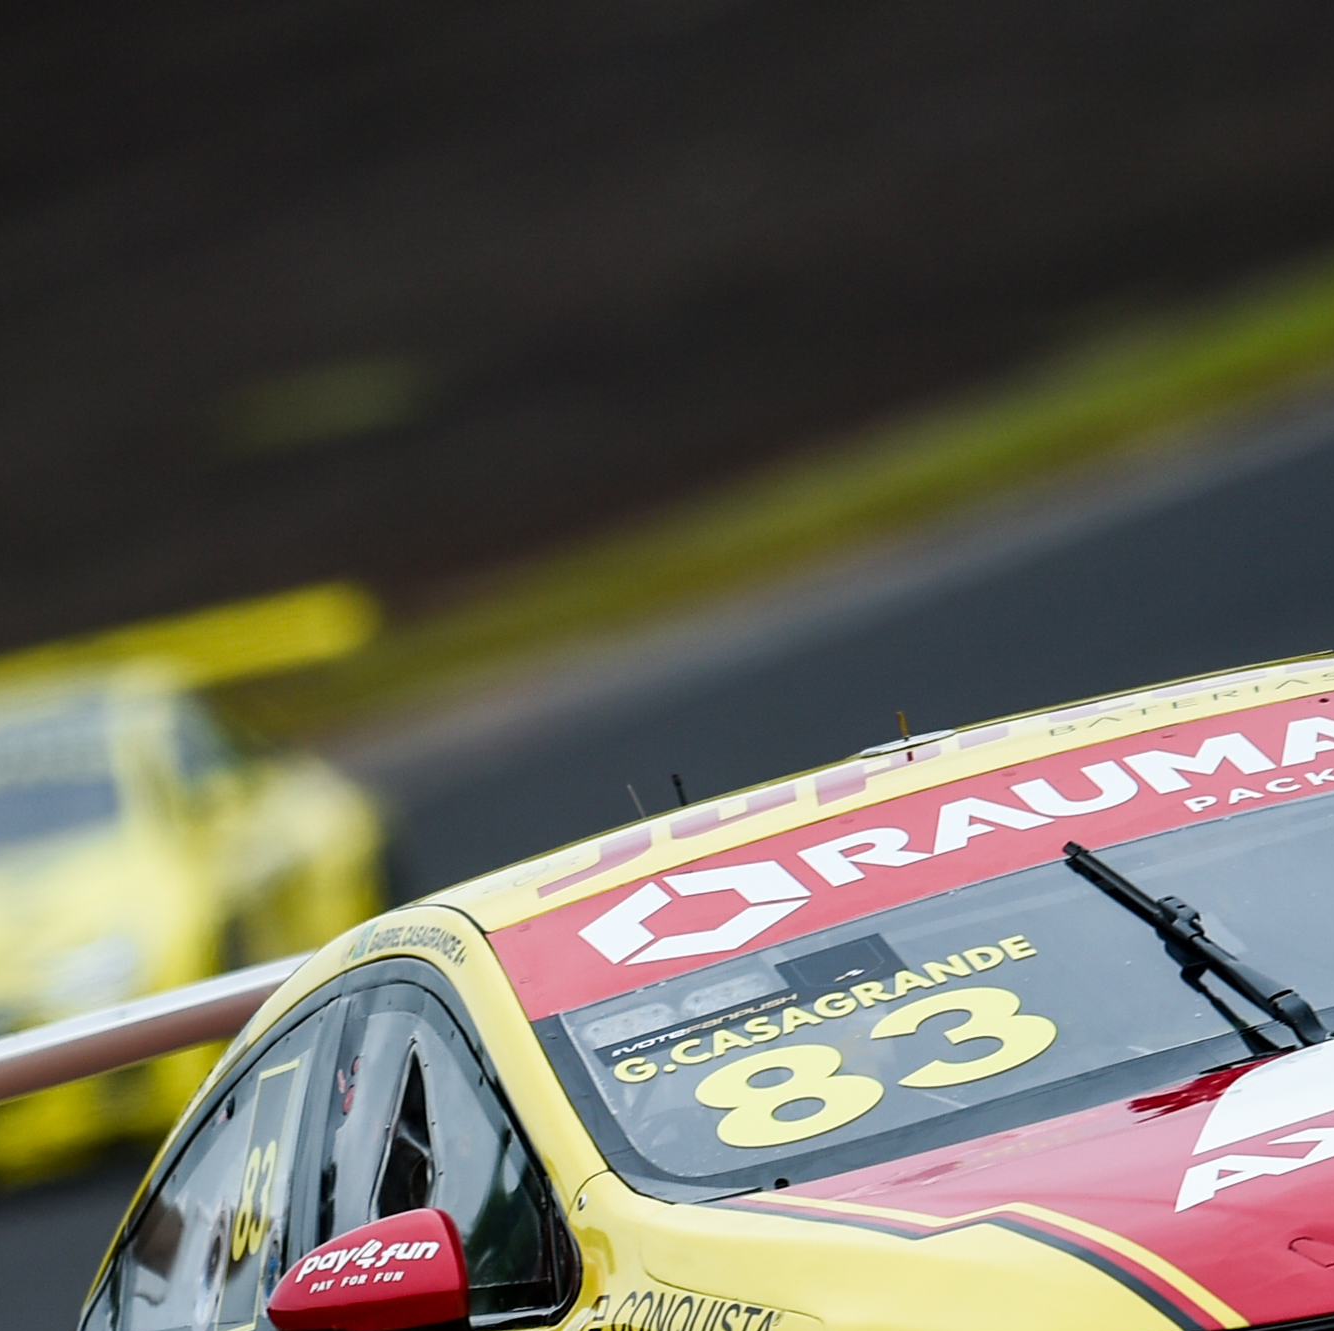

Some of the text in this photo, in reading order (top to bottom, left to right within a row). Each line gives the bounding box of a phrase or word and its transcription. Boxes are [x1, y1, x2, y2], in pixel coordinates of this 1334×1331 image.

[613, 934, 1037, 1083] G.CASAGRANDE
[695, 987, 1058, 1148] 83
[232, 1141, 277, 1262] 83
[295, 1239, 440, 1283] pay4fun
[309, 1271, 405, 1294] PAY FOR FUN
